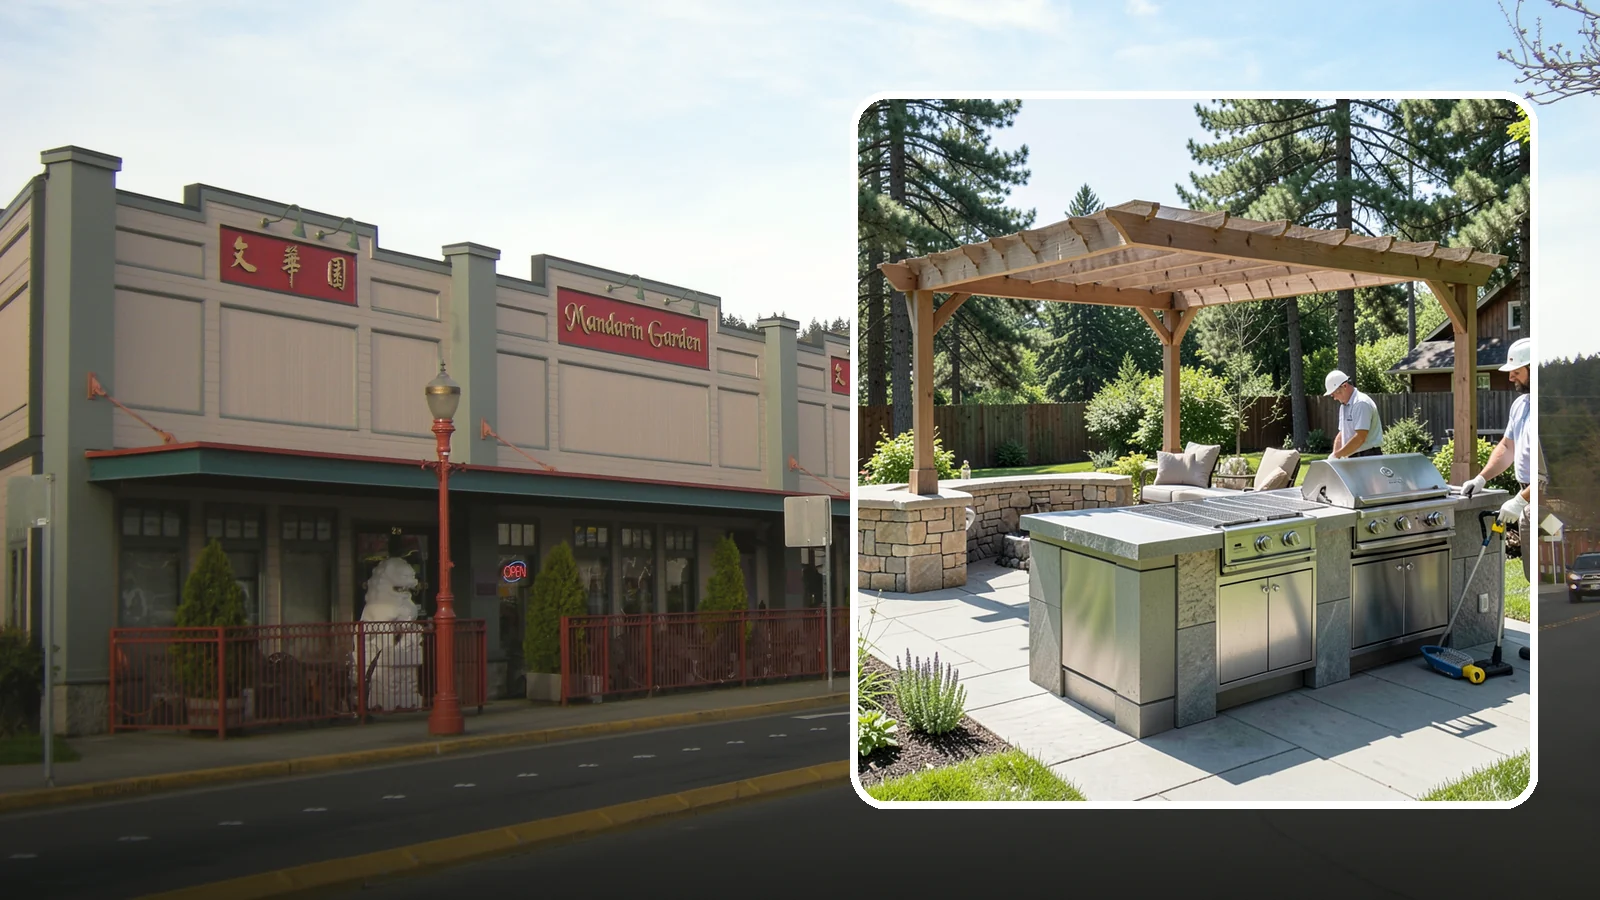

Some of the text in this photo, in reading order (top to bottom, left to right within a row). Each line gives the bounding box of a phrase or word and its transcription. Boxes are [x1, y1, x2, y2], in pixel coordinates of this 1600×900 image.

[231, 236, 346, 291] 文華園
[565, 303, 701, 352] Mandarin Garden
[503, 565, 527, 578] OPEN
